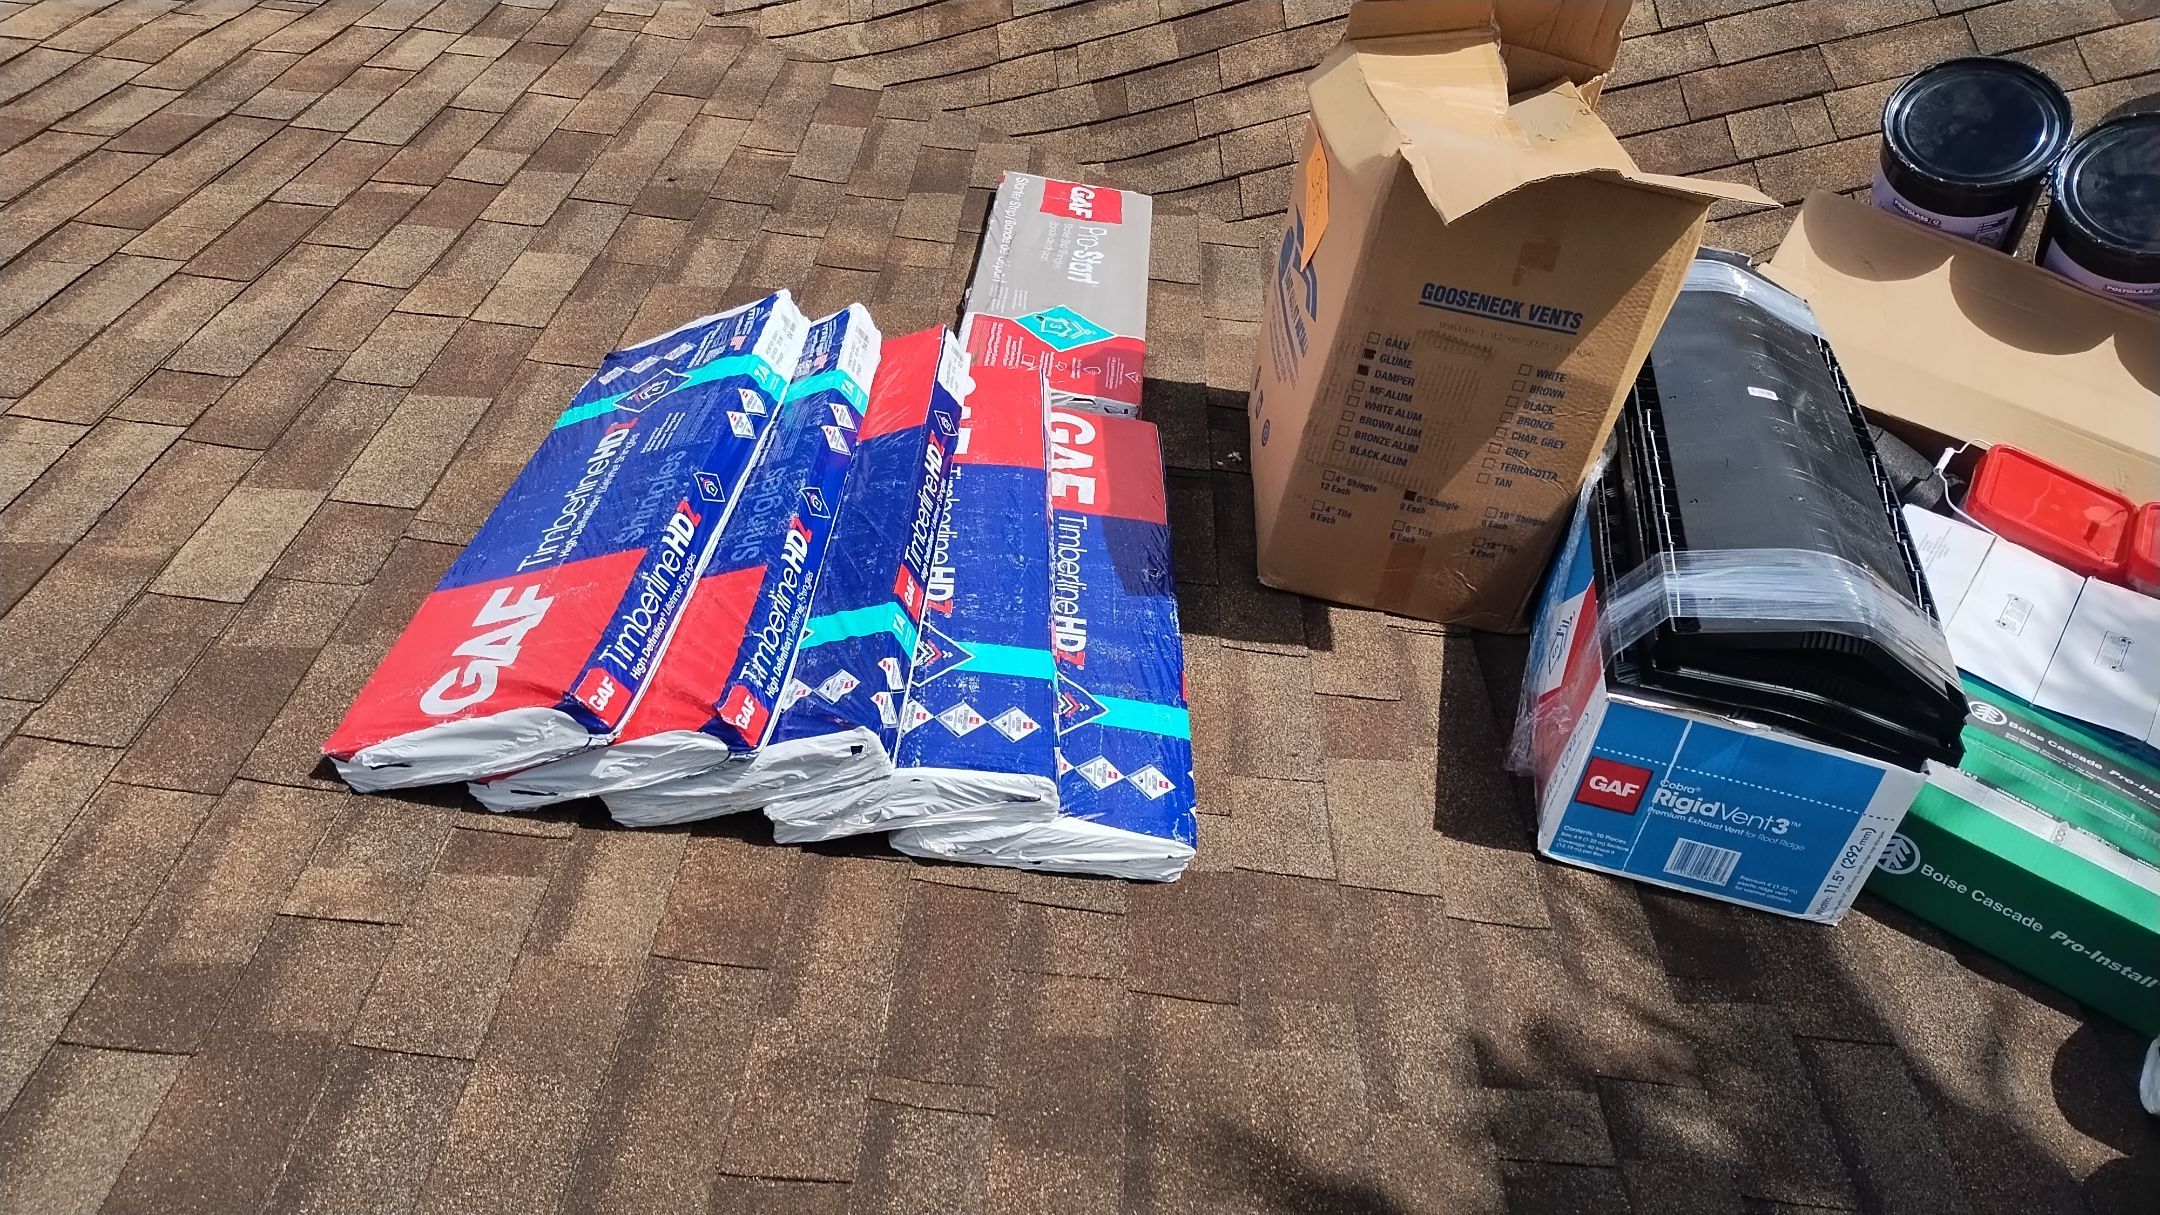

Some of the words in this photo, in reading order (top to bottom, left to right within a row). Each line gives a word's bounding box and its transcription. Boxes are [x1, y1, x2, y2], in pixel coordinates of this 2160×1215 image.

[1068, 186, 1096, 220] GAF
[1067, 226, 1107, 288] Pro-Start
[1421, 282, 1524, 318] GOOSENECK
[1528, 304, 1584, 329] VENTS
[1385, 338, 1410, 350] GALV
[1380, 354, 1414, 370] GLUME
[1374, 370, 1416, 387] DAMPER
[1536, 368, 1568, 382] WHITE
[1384, 388, 1413, 403] ALUM
[1530, 384, 1566, 399] BROWN
[1364, 400, 1394, 416] WHITE
[1395, 408, 1423, 422] ALUM
[1523, 400, 1555, 414] BLACK
[1360, 416, 1394, 431] BROWN
[1394, 424, 1422, 438] ALUM
[1516, 416, 1554, 431] BRONZE
[1354, 430, 1390, 446] BRONZE
[1392, 440, 1419, 454] ALUM
[1512, 432, 1538, 446] CHAR.
[1540, 437, 1566, 450] GREY
[1050, 411, 1097, 505] GAF
[1350, 446, 1380, 460] BLACK
[1380, 454, 1408, 467] ALUM
[1506, 448, 1531, 460] GREY
[1500, 462, 1558, 481] TERRACOTTA
[1320, 482, 1330, 490] 12
[1331, 486, 1351, 496] Each
[1346, 478, 1378, 493] Shingle
[1494, 477, 1512, 488] TAN
[613, 449, 687, 545] Shingles
[1428, 498, 1460, 511] Shingle
[731, 465, 787, 563] Shingles
[1337, 508, 1352, 520] Tile
[1406, 504, 1426, 514] Each
[1316, 514, 1336, 524] Each
[1488, 521, 1508, 530] Each
[1516, 514, 1546, 526] Shingle
[1396, 533, 1416, 544] Each
[1418, 528, 1432, 538] Tile
[1476, 550, 1496, 559] Each
[1503, 544, 1518, 554] Tile
[904, 574, 917, 607] GAF
[630, 654, 648, 681] High
[678, 552, 698, 586] Shingles
[419, 582, 556, 716] GAF
[588, 675, 616, 712] GAF
[765, 674, 781, 700] High
[734, 694, 756, 730] GAF
[2008, 720, 2046, 742] Boise
[2048, 740, 2103, 770] Cascade
[1589, 775, 1640, 798] GAF
[1563, 824, 1594, 836] Contents:
[1604, 835, 1626, 844] Pieces
[1648, 806, 1686, 822] Premium
[1688, 816, 1723, 831] Exhaust
[1724, 825, 1745, 836] Vent
[1746, 830, 1757, 840] for
[1758, 834, 1779, 844] Roof
[1780, 839, 1806, 852] Ridge
[1824, 870, 1845, 894] 11.5"
[1920, 863, 1968, 894] Boise
[1971, 890, 2044, 932] Cascade
[2050, 930, 2158, 988] Pro-Install
